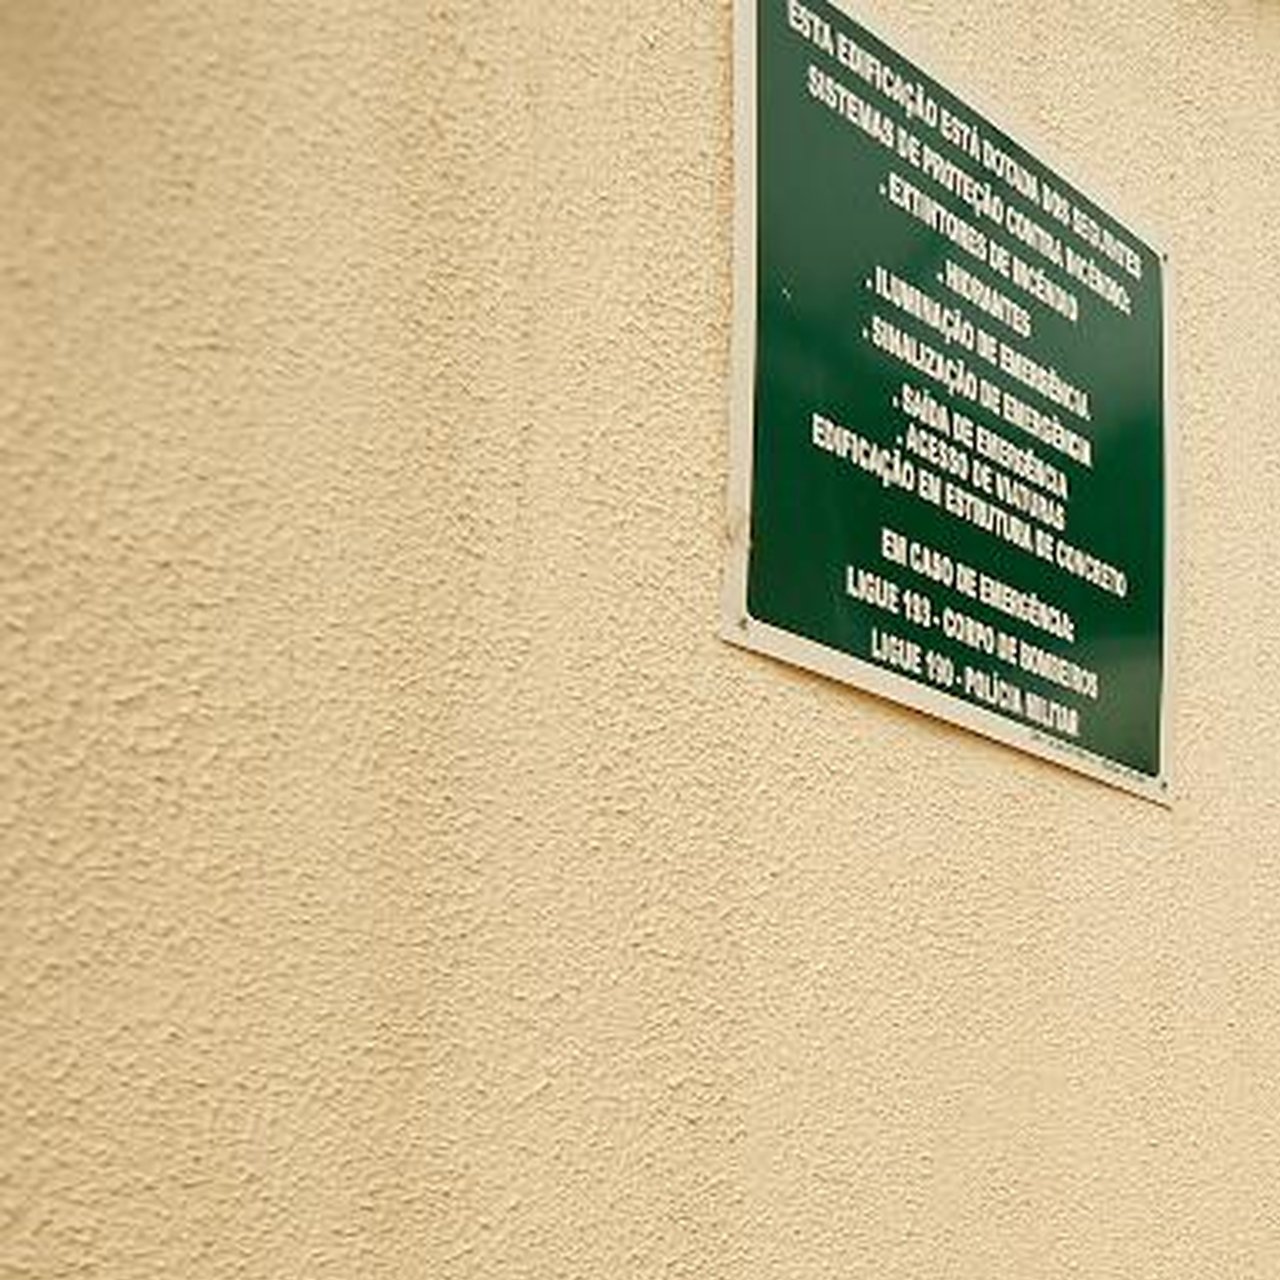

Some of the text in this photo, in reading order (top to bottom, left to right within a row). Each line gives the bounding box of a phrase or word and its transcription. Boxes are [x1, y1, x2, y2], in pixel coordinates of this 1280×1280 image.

[787, 0, 833, 55] ESTA
[837, 32, 937, 127] EDIFICAÇÃO
[940, 108, 980, 161] ESTÁ
[982, 139, 1040, 204] DOTADA
[807, 64, 894, 147] SISTEMAS
[897, 126, 920, 167] DE
[922, 144, 1003, 224] PROTEÇÃO
[1006, 206, 1063, 267] CONTRA
[889, 171, 986, 260] EXTINTORES
[989, 239, 1010, 277] DE
[872, 315, 977, 400] SINALIZAÇÃO
[980, 379, 1000, 415] DE
[875, 265, 974, 350] ILUMINAÇÃO
[976, 328, 997, 365] DE
[906, 423, 968, 479] ACESSO
[972, 459, 992, 493] DE
[953, 412, 973, 448] DE
[812, 413, 1126, 597] EDIFICAÇÃO EM ESTRUTURA DE CONCRETO
[882, 528, 906, 565] EM
[910, 542, 953, 586] CASO
[956, 563, 976, 597] DE
[847, 565, 898, 613] LIGUE
[902, 589, 930, 627] 193
[943, 607, 994, 653] CORPO
[997, 632, 1016, 664] DE
[1020, 640, 1097, 698] BOMBEIROS
[872, 628, 921, 673] LIGUE
[925, 650, 953, 686] 190
[965, 666, 1022, 713] POLÍCIA
[1025, 692, 1079, 736] MILITAR
